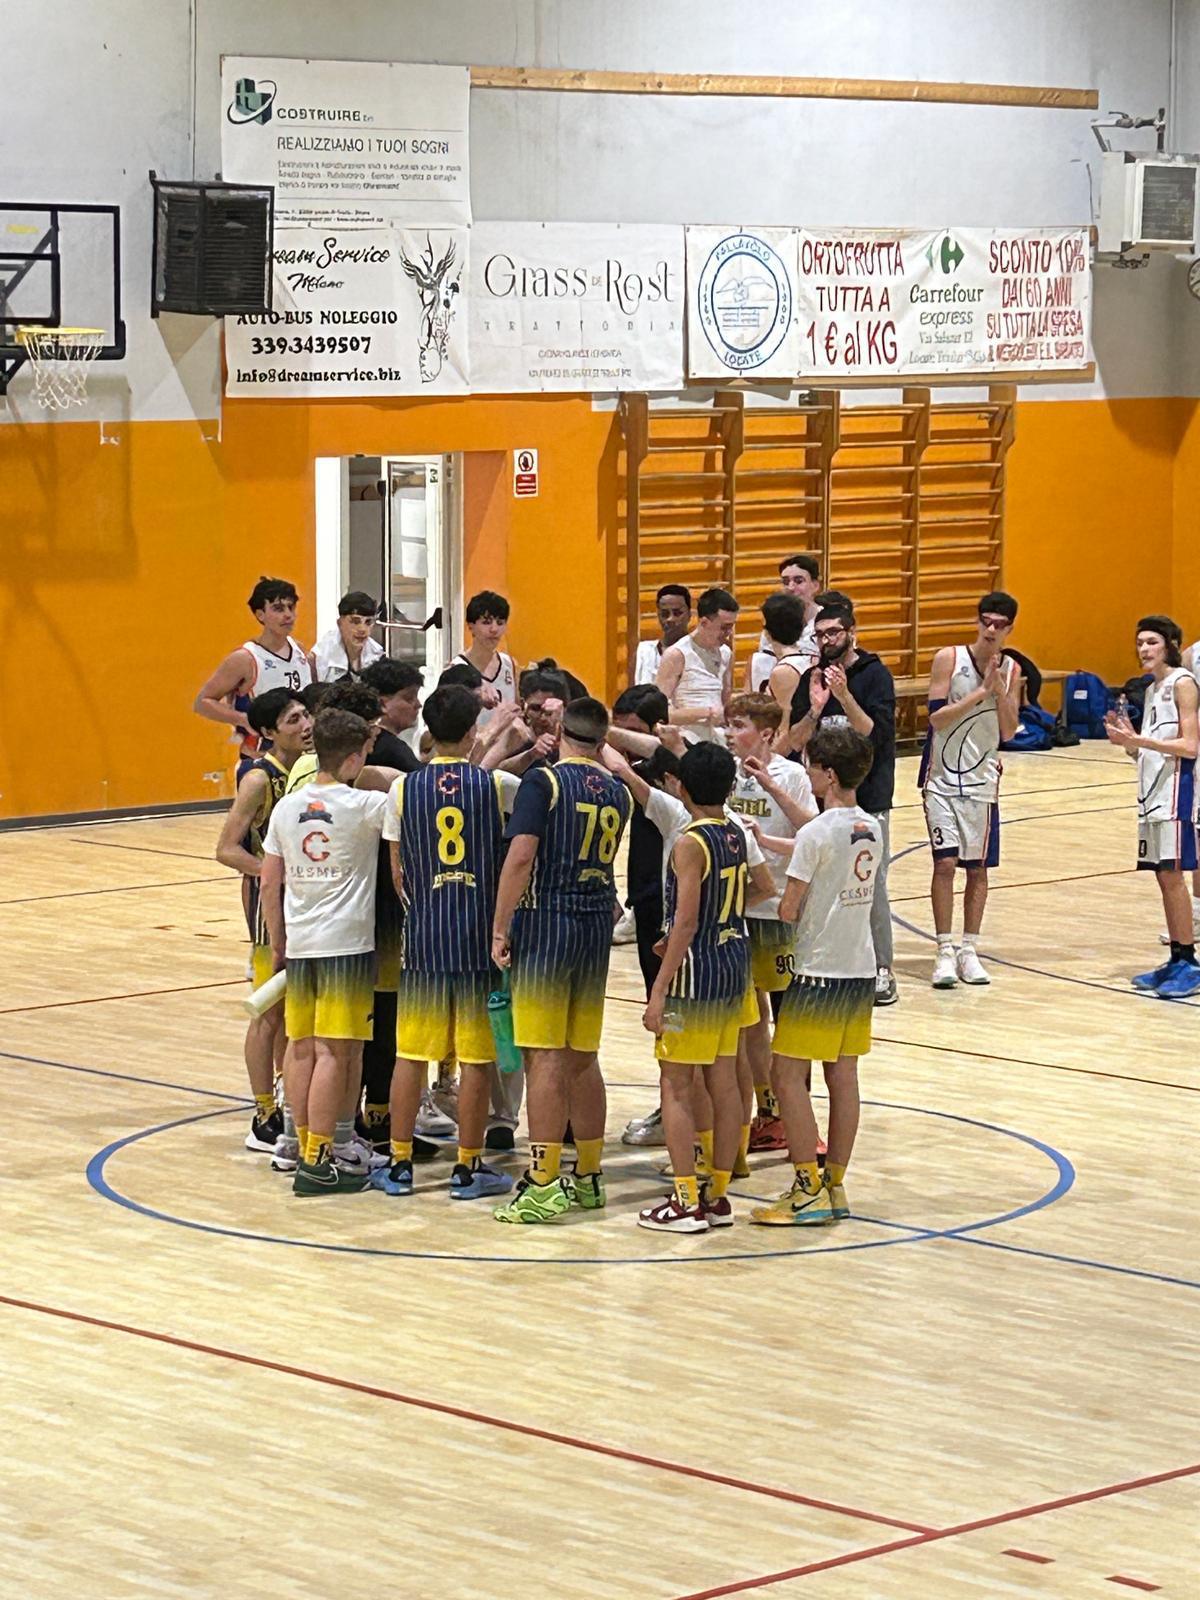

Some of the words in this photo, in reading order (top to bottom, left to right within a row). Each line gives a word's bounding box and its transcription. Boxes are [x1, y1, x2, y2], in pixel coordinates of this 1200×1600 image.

[277, 108, 361, 121] COSTRUIRE
[277, 136, 364, 152] REALIZZIAMO
[376, 139, 407, 153] TUOI
[411, 140, 448, 154] SOGNI
[316, 237, 390, 269] Service
[802, 240, 904, 275] ORTOFRUTTA
[989, 240, 1052, 273] SCONTO
[1056, 240, 1084, 272] 10%
[287, 273, 344, 292] Milano
[484, 254, 588, 297] Grass
[606, 259, 675, 315] Rost
[910, 283, 984, 303] Carrefour
[1002, 278, 1023, 307] DAI
[1045, 278, 1072, 307] ANNI
[816, 286, 873, 312] TUTTA
[878, 287, 890, 312] A
[320, 311, 398, 325] NOLEGGIO
[920, 311, 974, 328] express
[987, 313, 1000, 338] SU
[1003, 312, 1035, 338] TUTTA
[1051, 311, 1083, 337] SPESA
[251, 336, 371, 354] 339.3439507
[807, 321, 816, 366] 1
[825, 321, 838, 365] €
[867, 321, 897, 365] KG
[436, 806, 464, 865] 8
[576, 802, 620, 864] 78
[933, 826, 943, 845] 3
